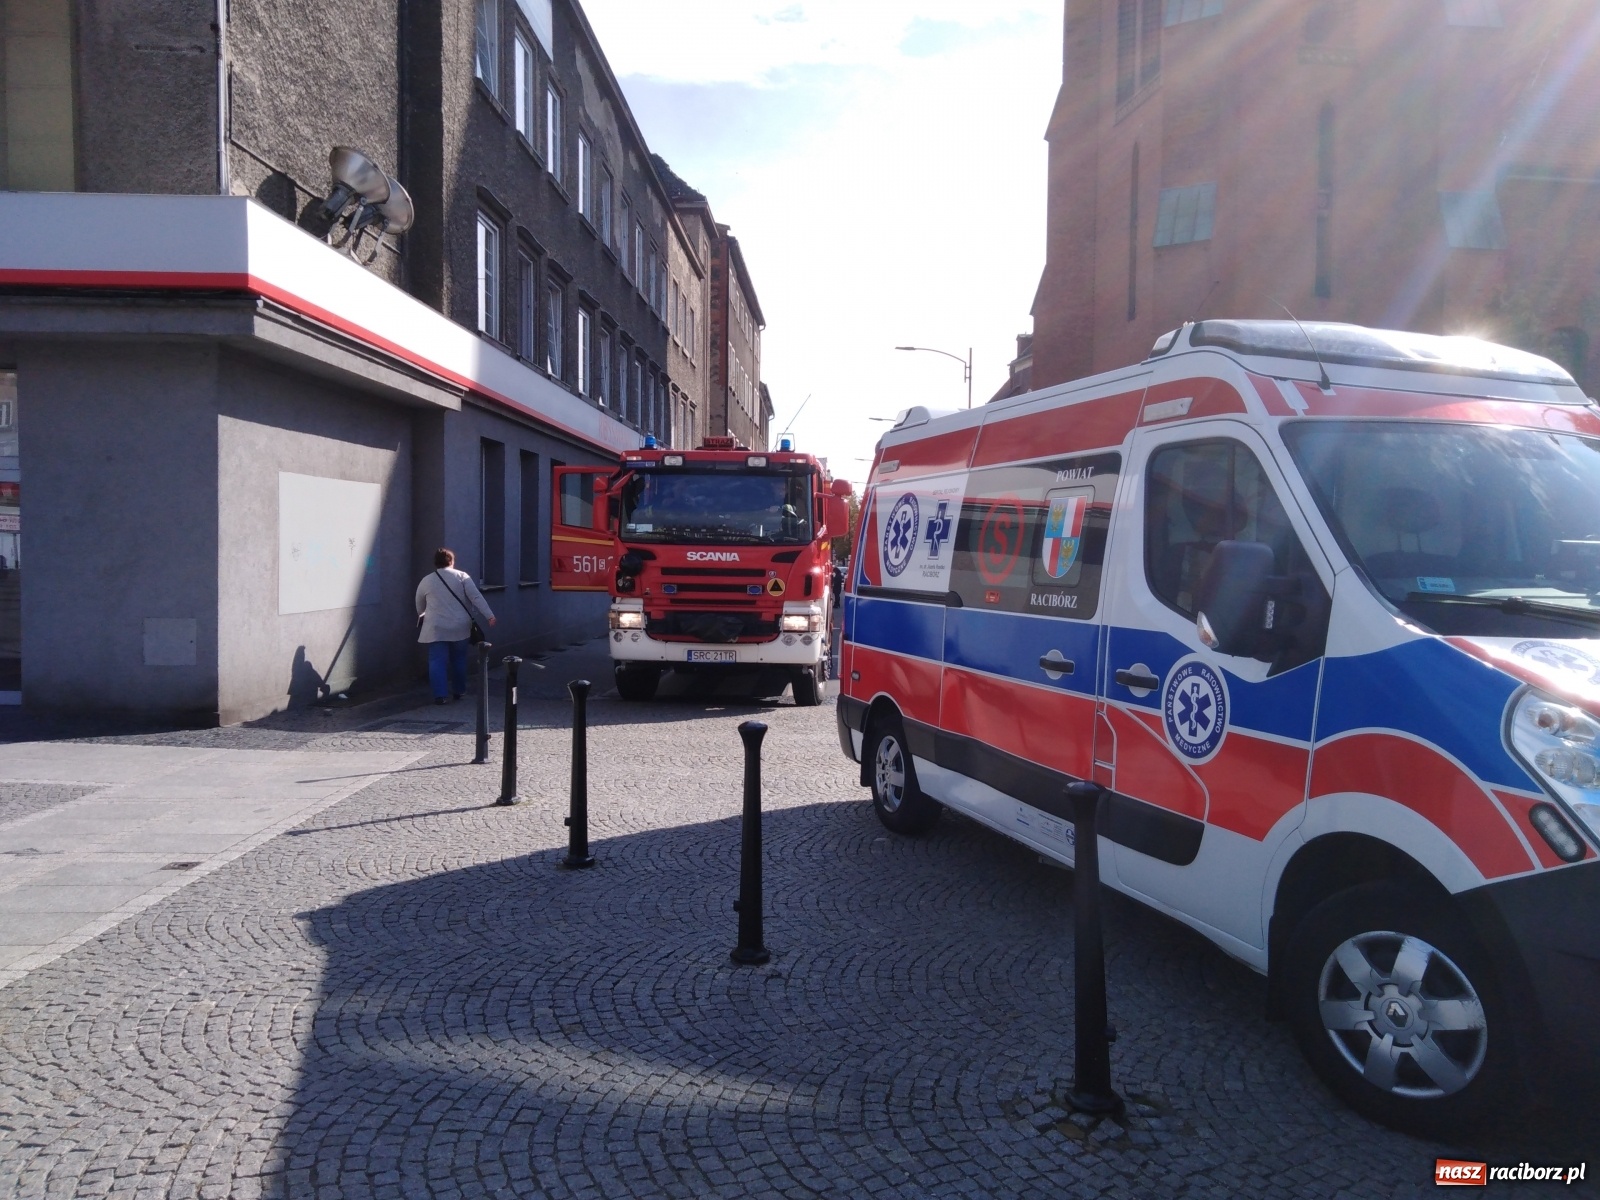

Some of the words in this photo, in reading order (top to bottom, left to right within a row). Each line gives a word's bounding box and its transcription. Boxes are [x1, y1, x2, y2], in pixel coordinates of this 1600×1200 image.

[1056, 466, 1094, 483] POWIAT
[686, 551, 740, 562] SCANIA
[1030, 591, 1078, 609] RACIBÓRZ
[693, 651, 711, 660] SRC
[713, 651, 735, 661] 21TR
[1201, 668, 1224, 734] RATOWNICTWO
[1174, 733, 1211, 754] MEDYCZNE
